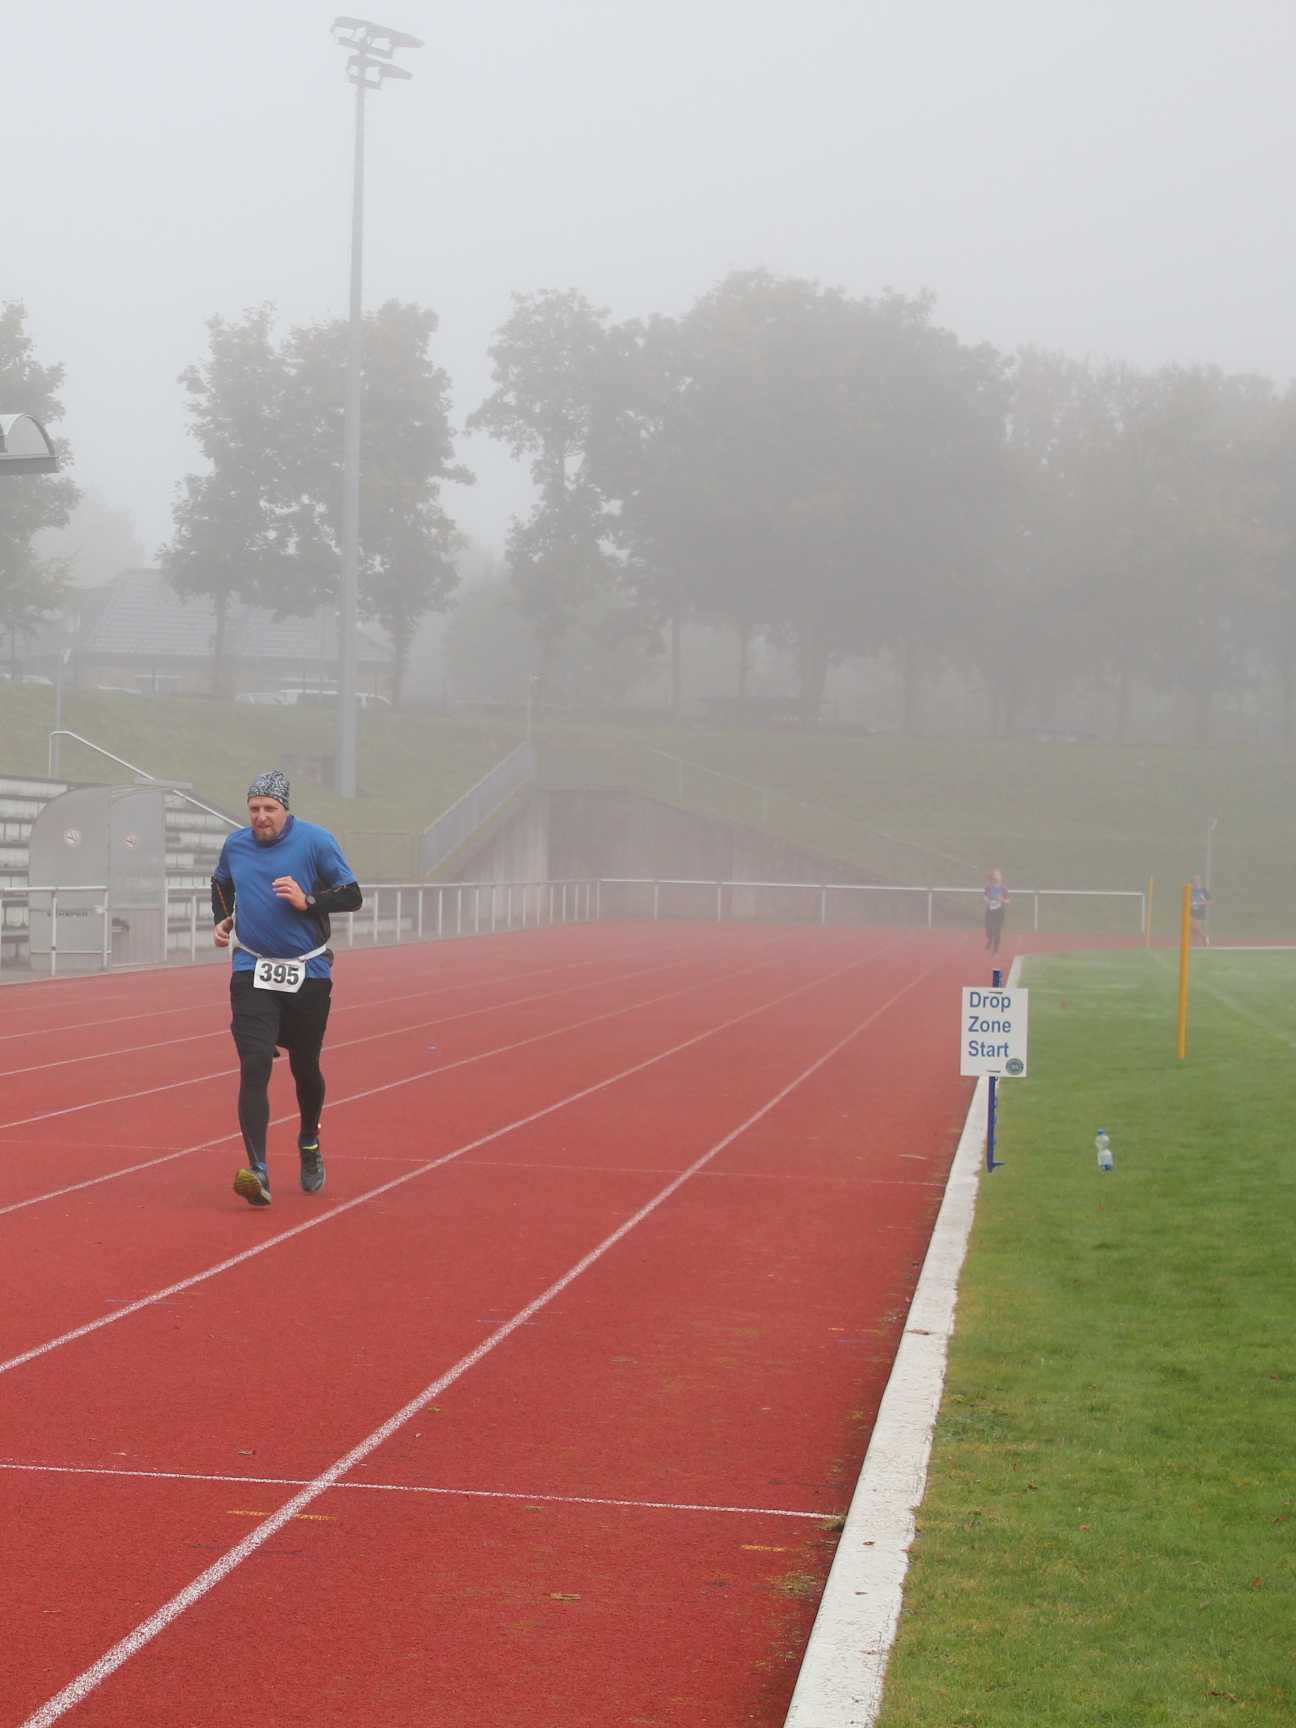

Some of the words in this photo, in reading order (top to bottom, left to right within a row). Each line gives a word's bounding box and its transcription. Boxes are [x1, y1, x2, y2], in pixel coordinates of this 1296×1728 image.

[260, 963, 299, 985] 395
[969, 991, 1011, 1013] Drop
[968, 1015, 1012, 1033] Zone
[968, 1040, 1009, 1058] Start
